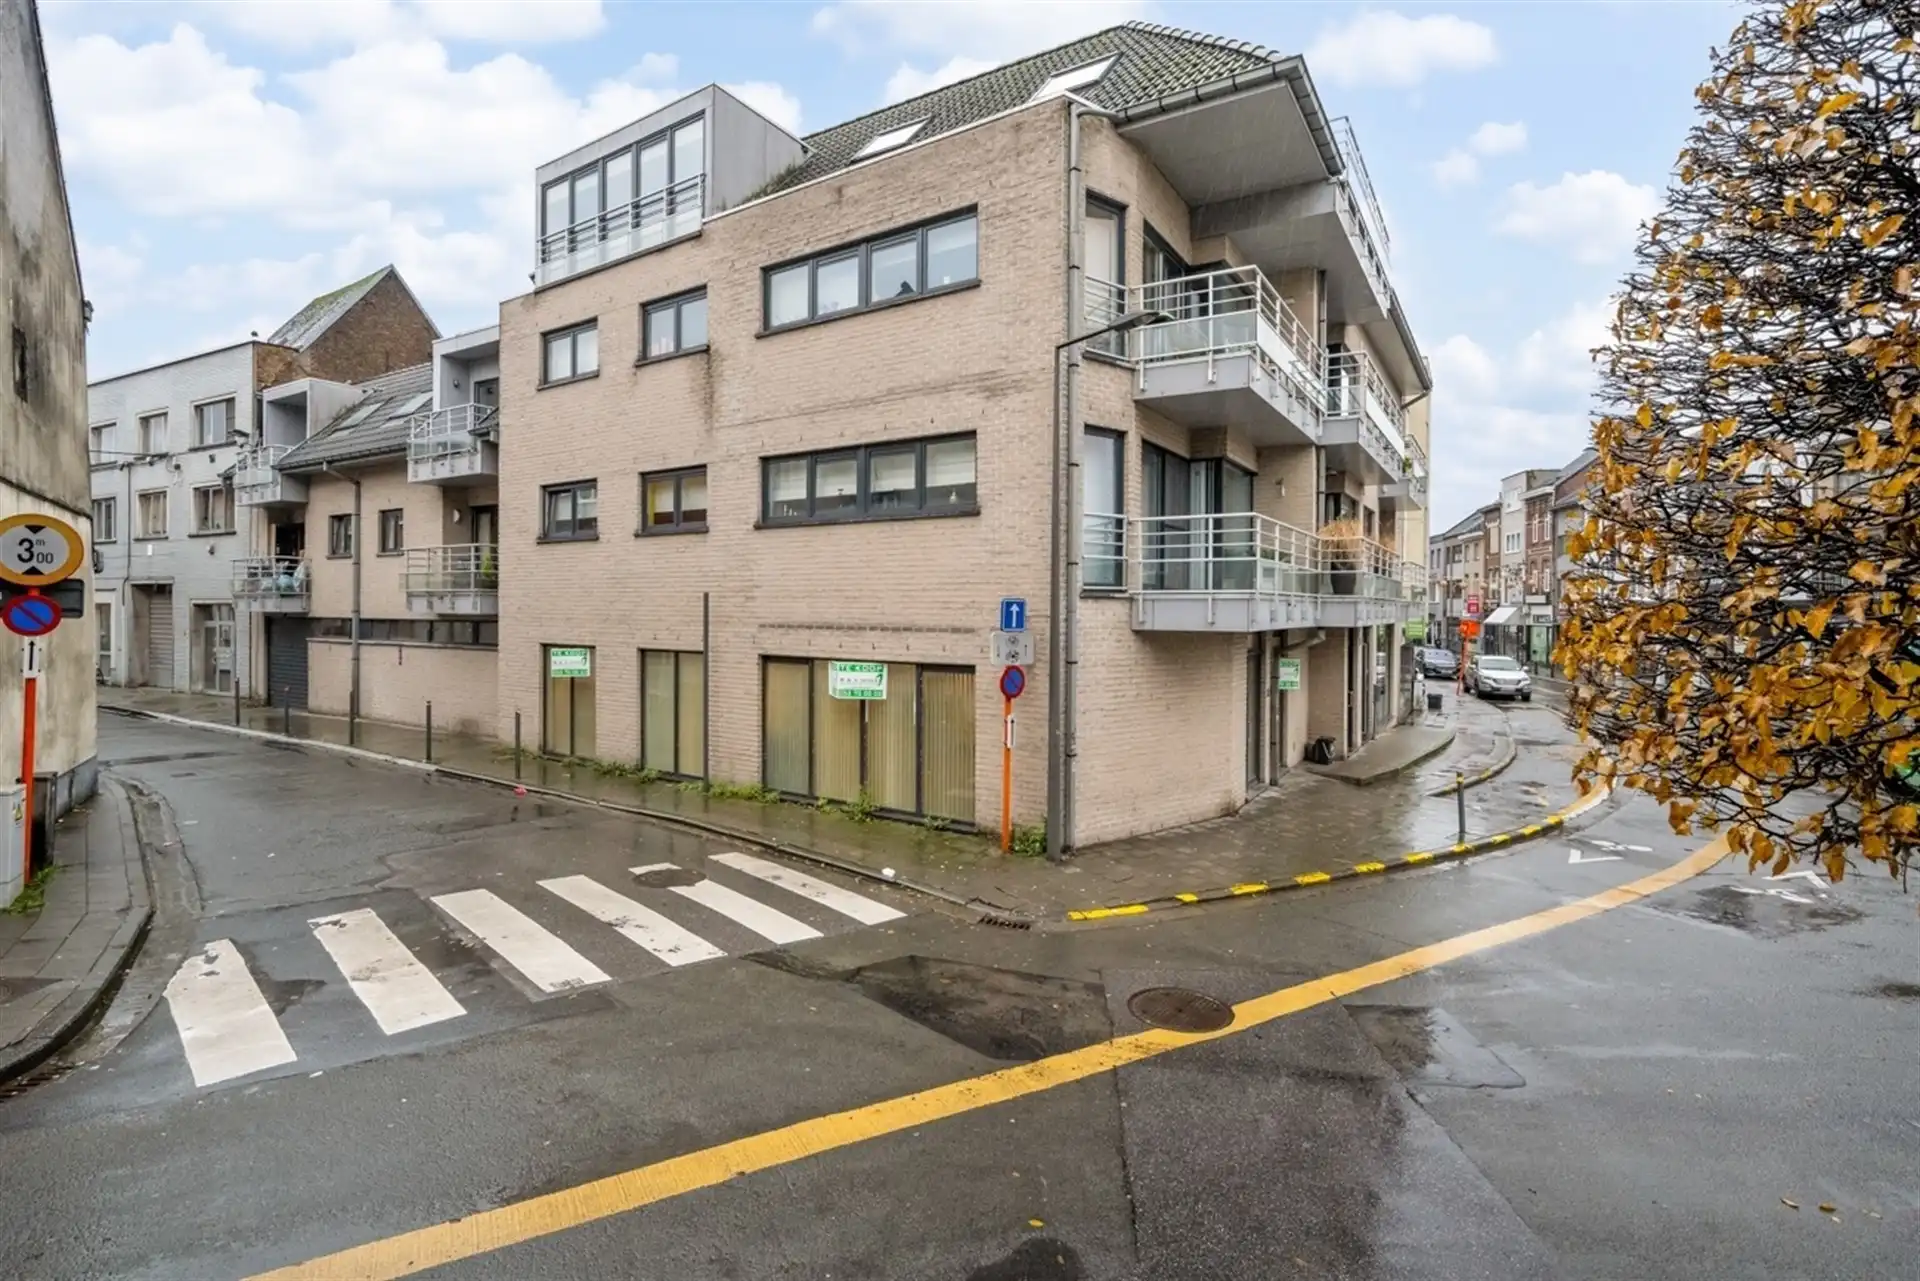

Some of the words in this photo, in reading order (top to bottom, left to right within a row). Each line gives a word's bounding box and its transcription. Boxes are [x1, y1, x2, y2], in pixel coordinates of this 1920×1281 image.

[17, 538, 34, 563] 3
[36, 552, 54, 564] 00
[854, 664, 883, 673] KOOP
